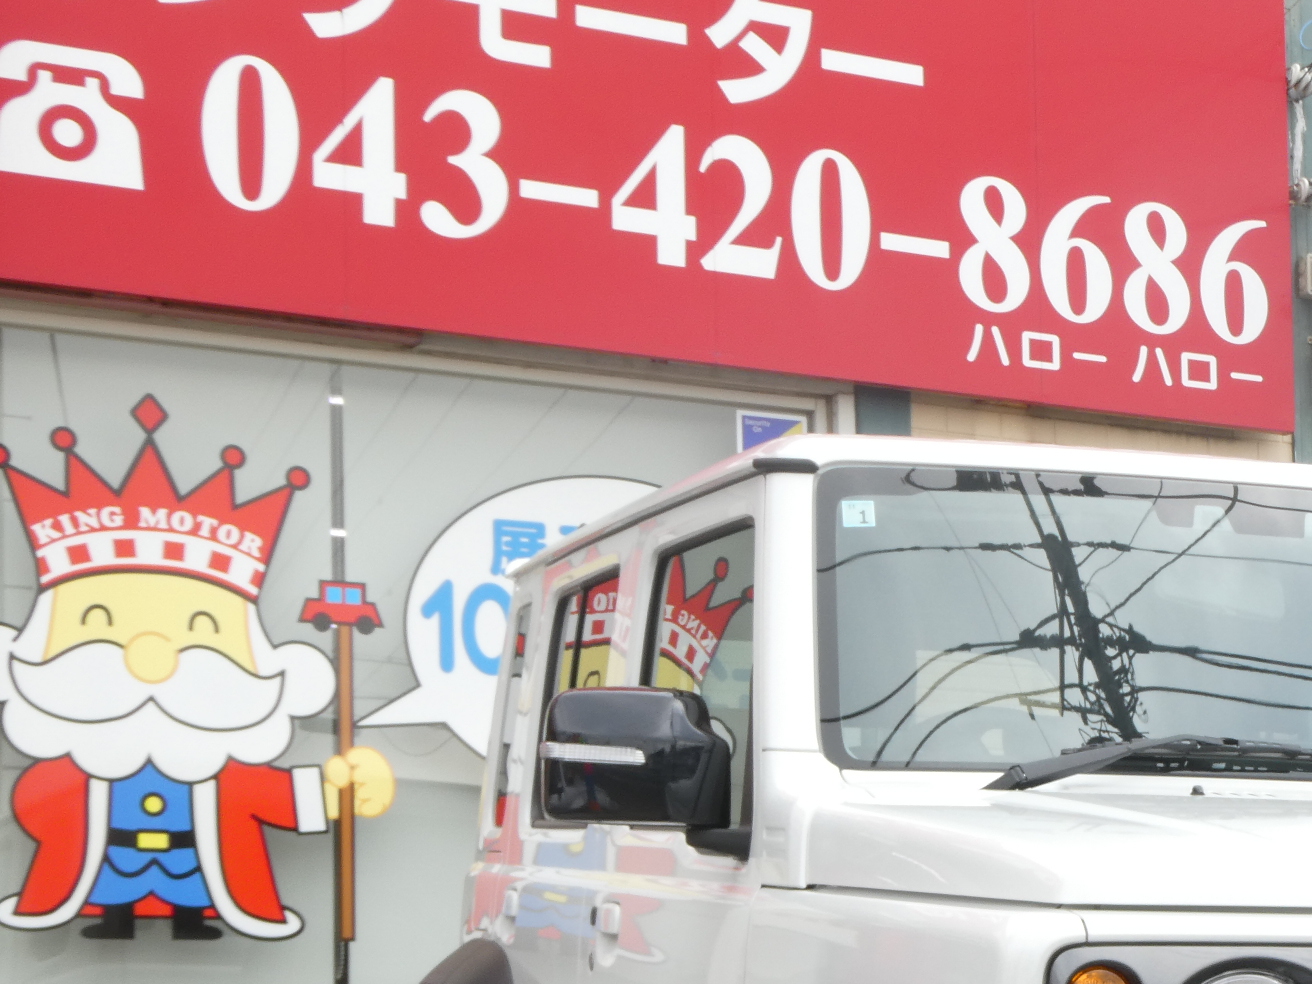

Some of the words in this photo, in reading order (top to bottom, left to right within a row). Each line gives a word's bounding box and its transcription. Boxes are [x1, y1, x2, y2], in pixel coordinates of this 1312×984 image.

[966, 323, 1108, 370] ハロー
[1132, 345, 1263, 390] ハロー
[30, 506, 125, 545] KING
[137, 506, 264, 558] MOTOR
[859, 509, 869, 524] 1
